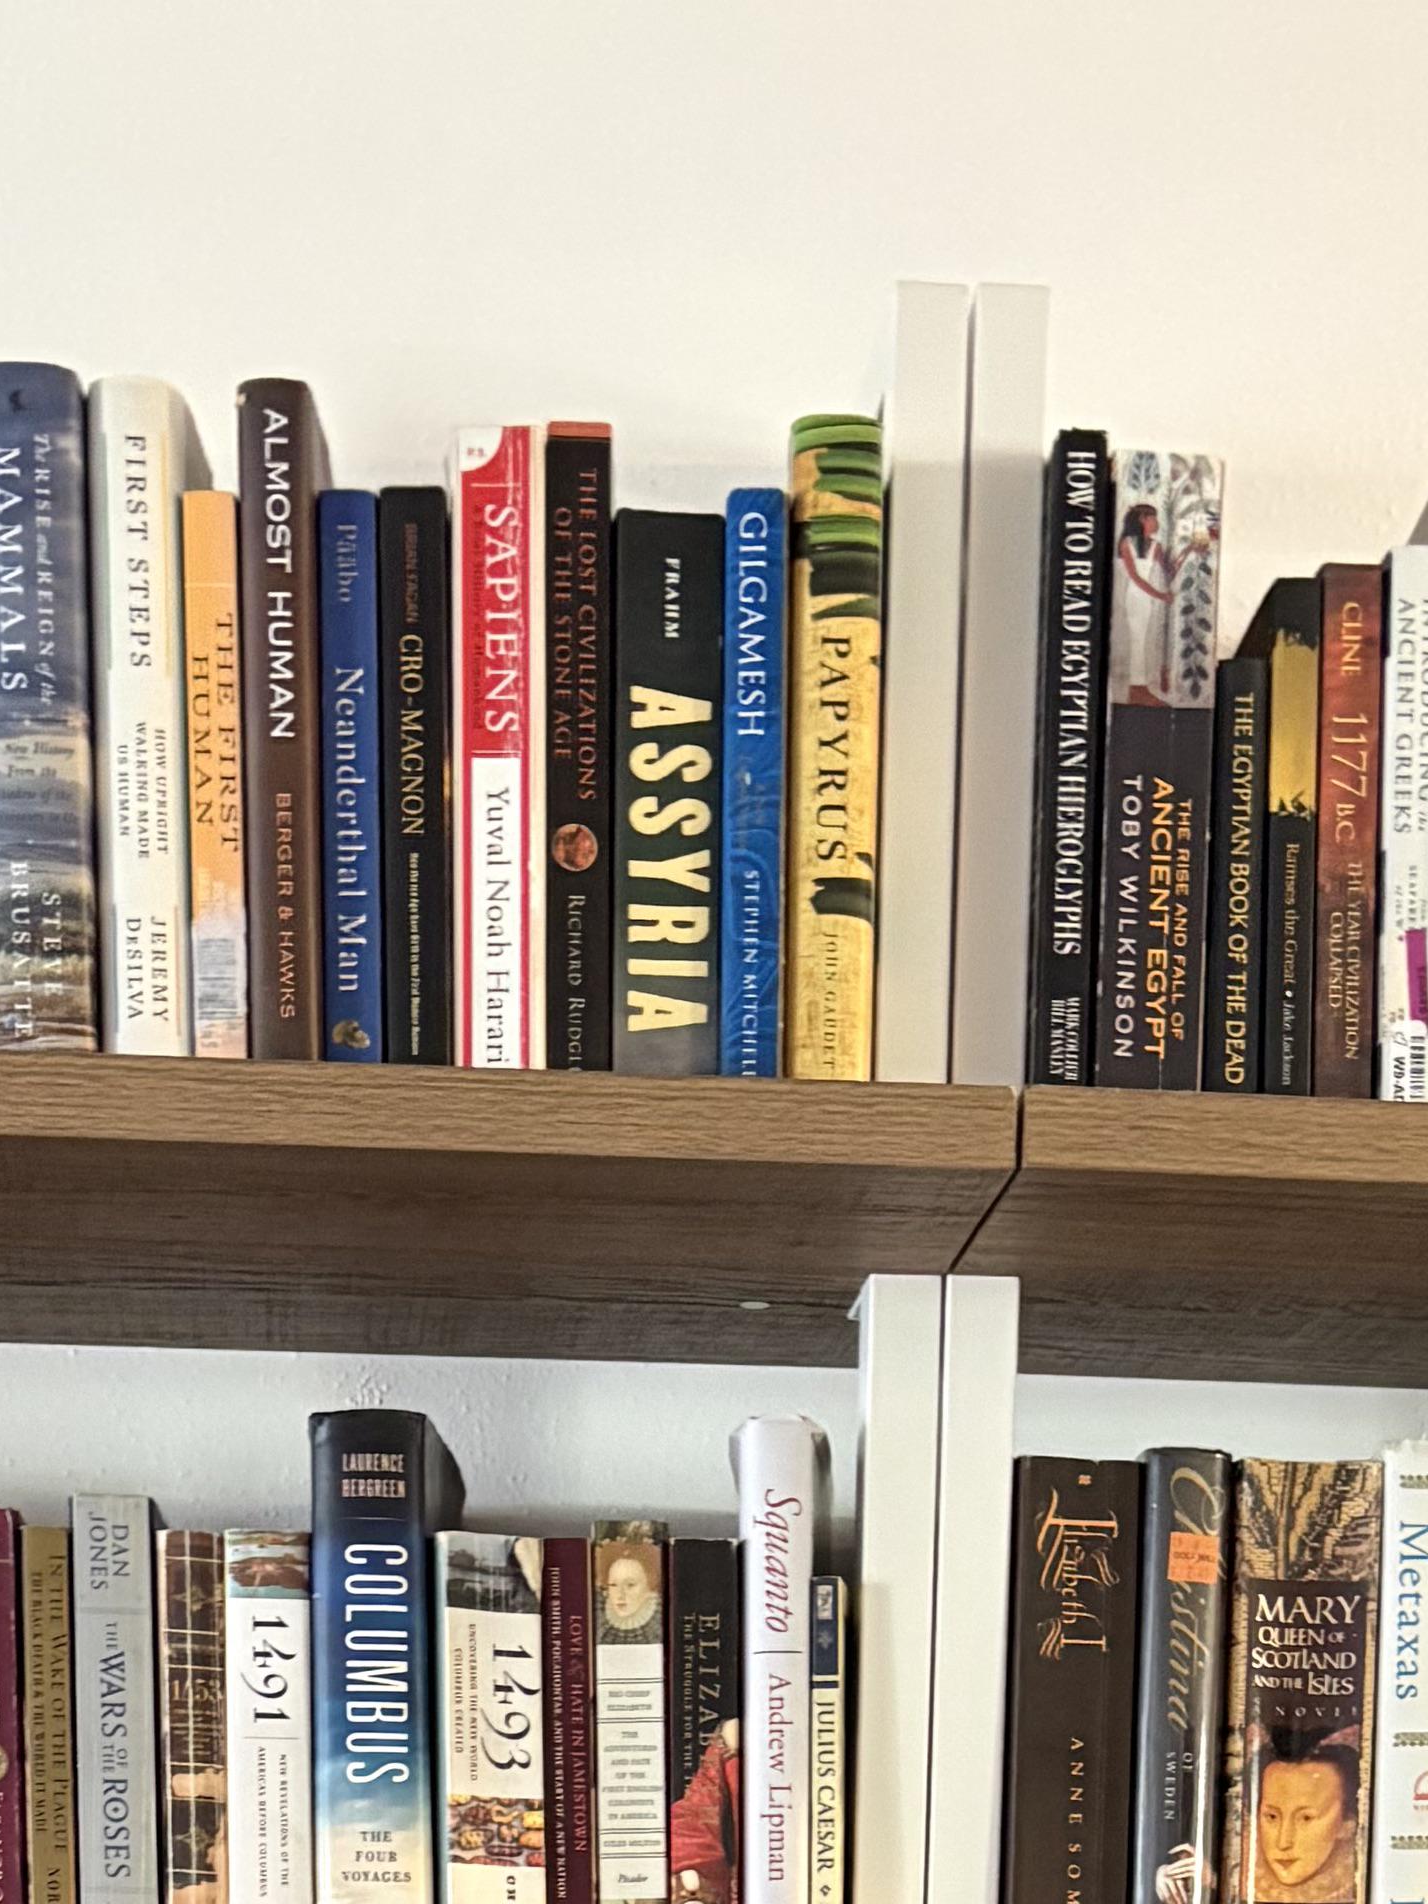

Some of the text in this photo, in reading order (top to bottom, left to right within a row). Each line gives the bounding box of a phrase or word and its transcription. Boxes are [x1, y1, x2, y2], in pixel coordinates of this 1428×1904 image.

[263, 408, 296, 739] ALMOST HUMAN
[482, 503, 519, 734] SAPIENS
[737, 512, 768, 737] GILGAMESH
[817, 635, 851, 861] PAPYRUS
[484, 788, 512, 1064] Yuval Noah Harari
[626, 685, 713, 1033] ASSYRIA
[1144, 776, 1175, 1059] ANCIENT EGYPT
[241, 1614, 289, 1723] 1491
[344, 1543, 408, 1788] COLUMBUS
[762, 1488, 803, 1633] Squanto
[1255, 1596, 1360, 1623] MARY
[480, 1643, 540, 1770] 1493
[762, 1673, 792, 1882] Andrew Lipman
[341, 1870, 412, 1884] VOYAGES
[356, 1850, 396, 1863] FOUR
[360, 1830, 392, 1842] THE
